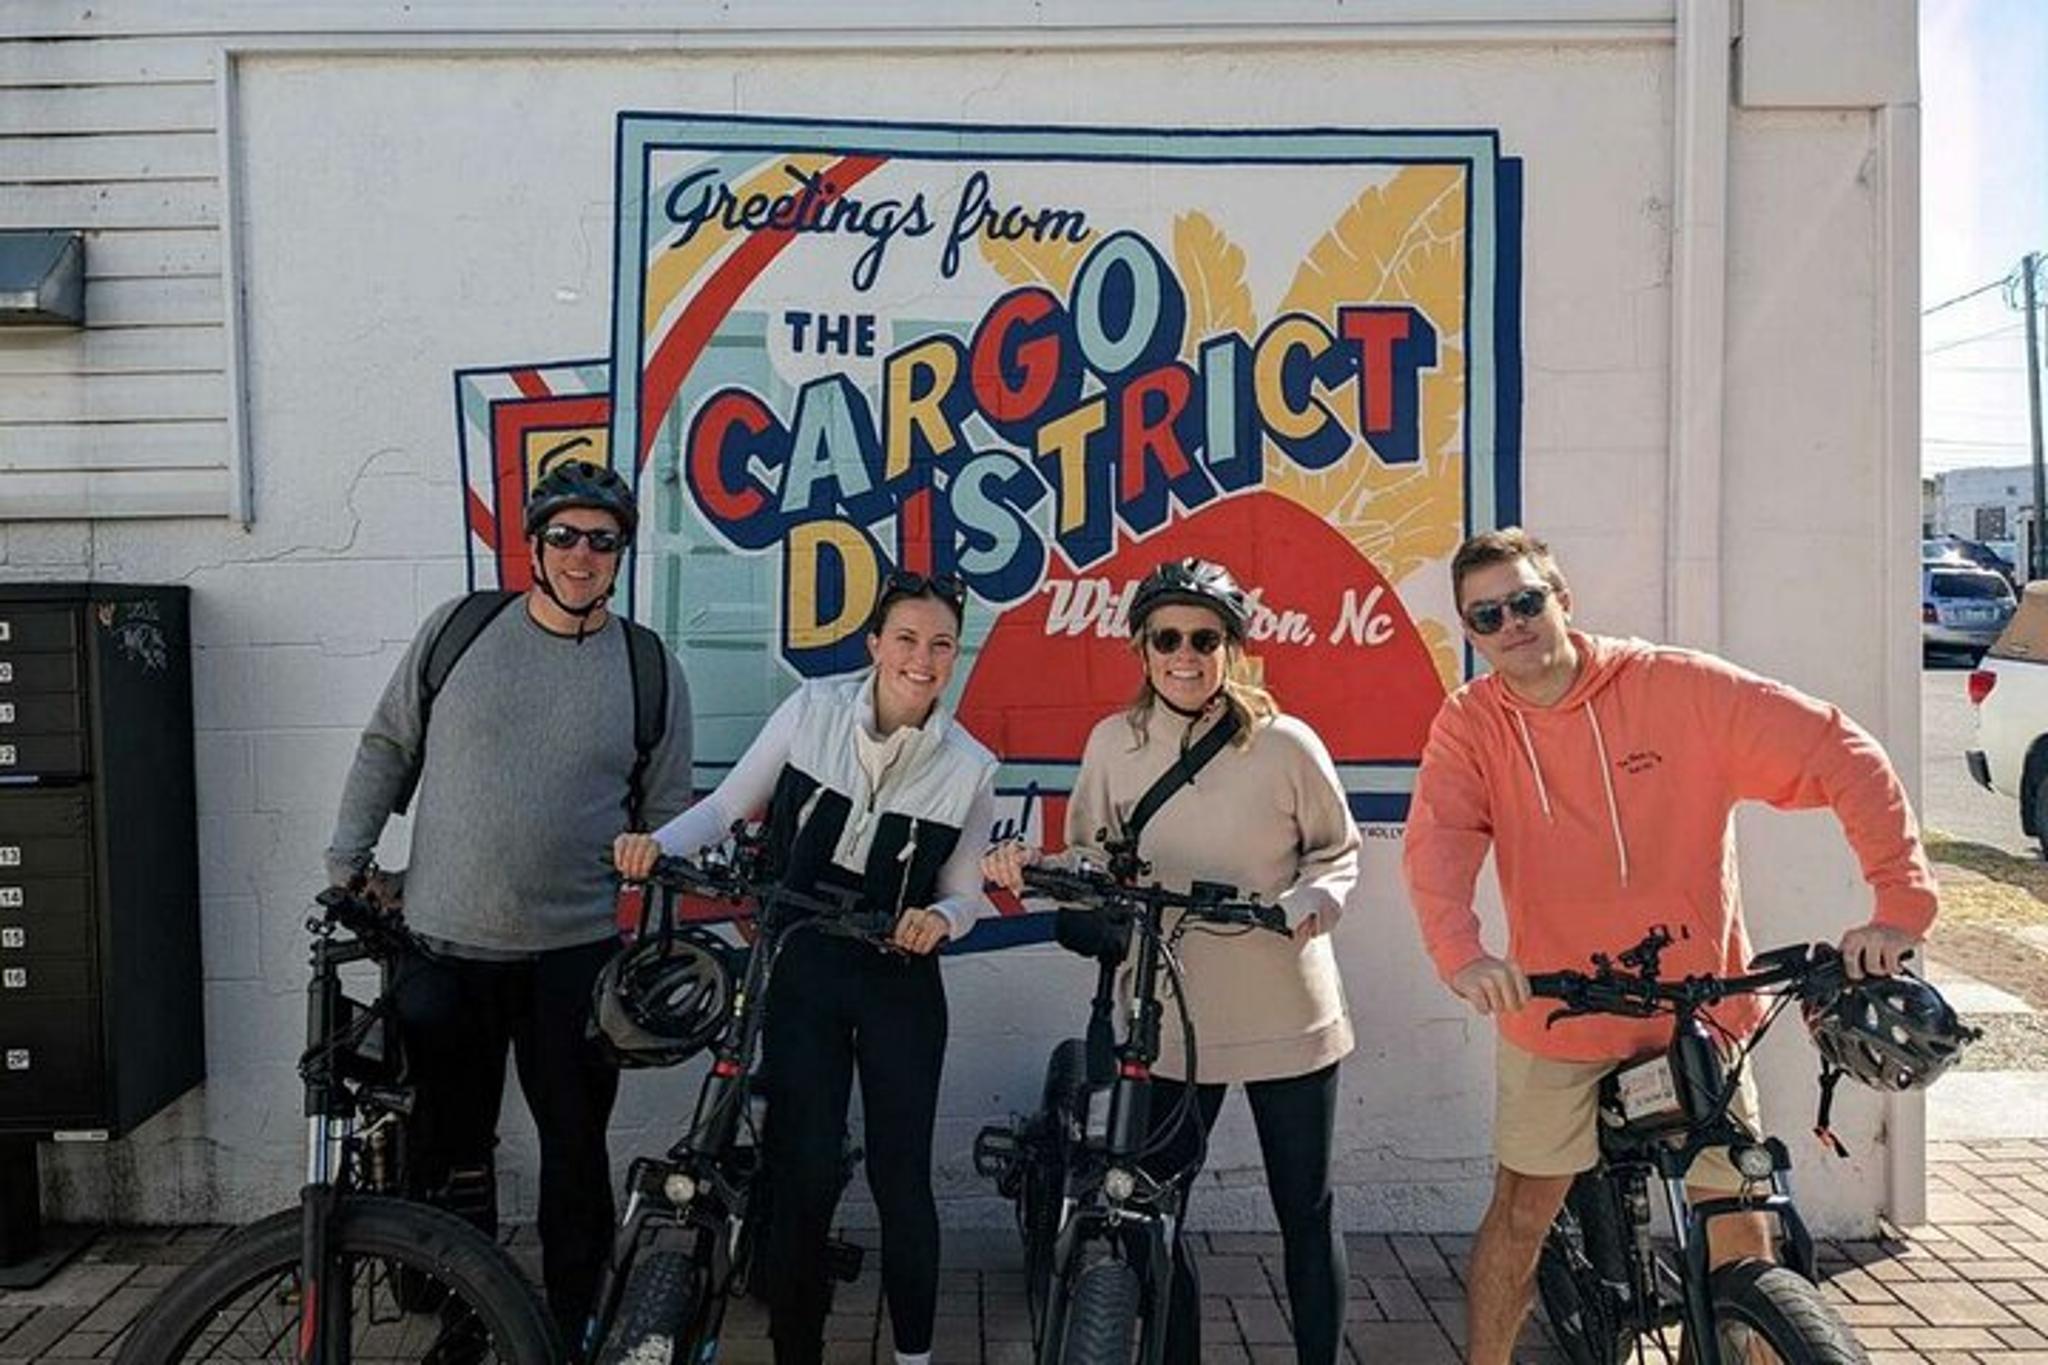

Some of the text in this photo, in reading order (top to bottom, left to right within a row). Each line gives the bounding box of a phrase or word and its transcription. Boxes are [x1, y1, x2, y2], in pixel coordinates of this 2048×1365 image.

[664, 164, 1091, 291] Greetings from
[785, 311, 877, 357] THE
[687, 228, 1184, 546] CARGO
[785, 307, 1428, 660] DISTRICT
